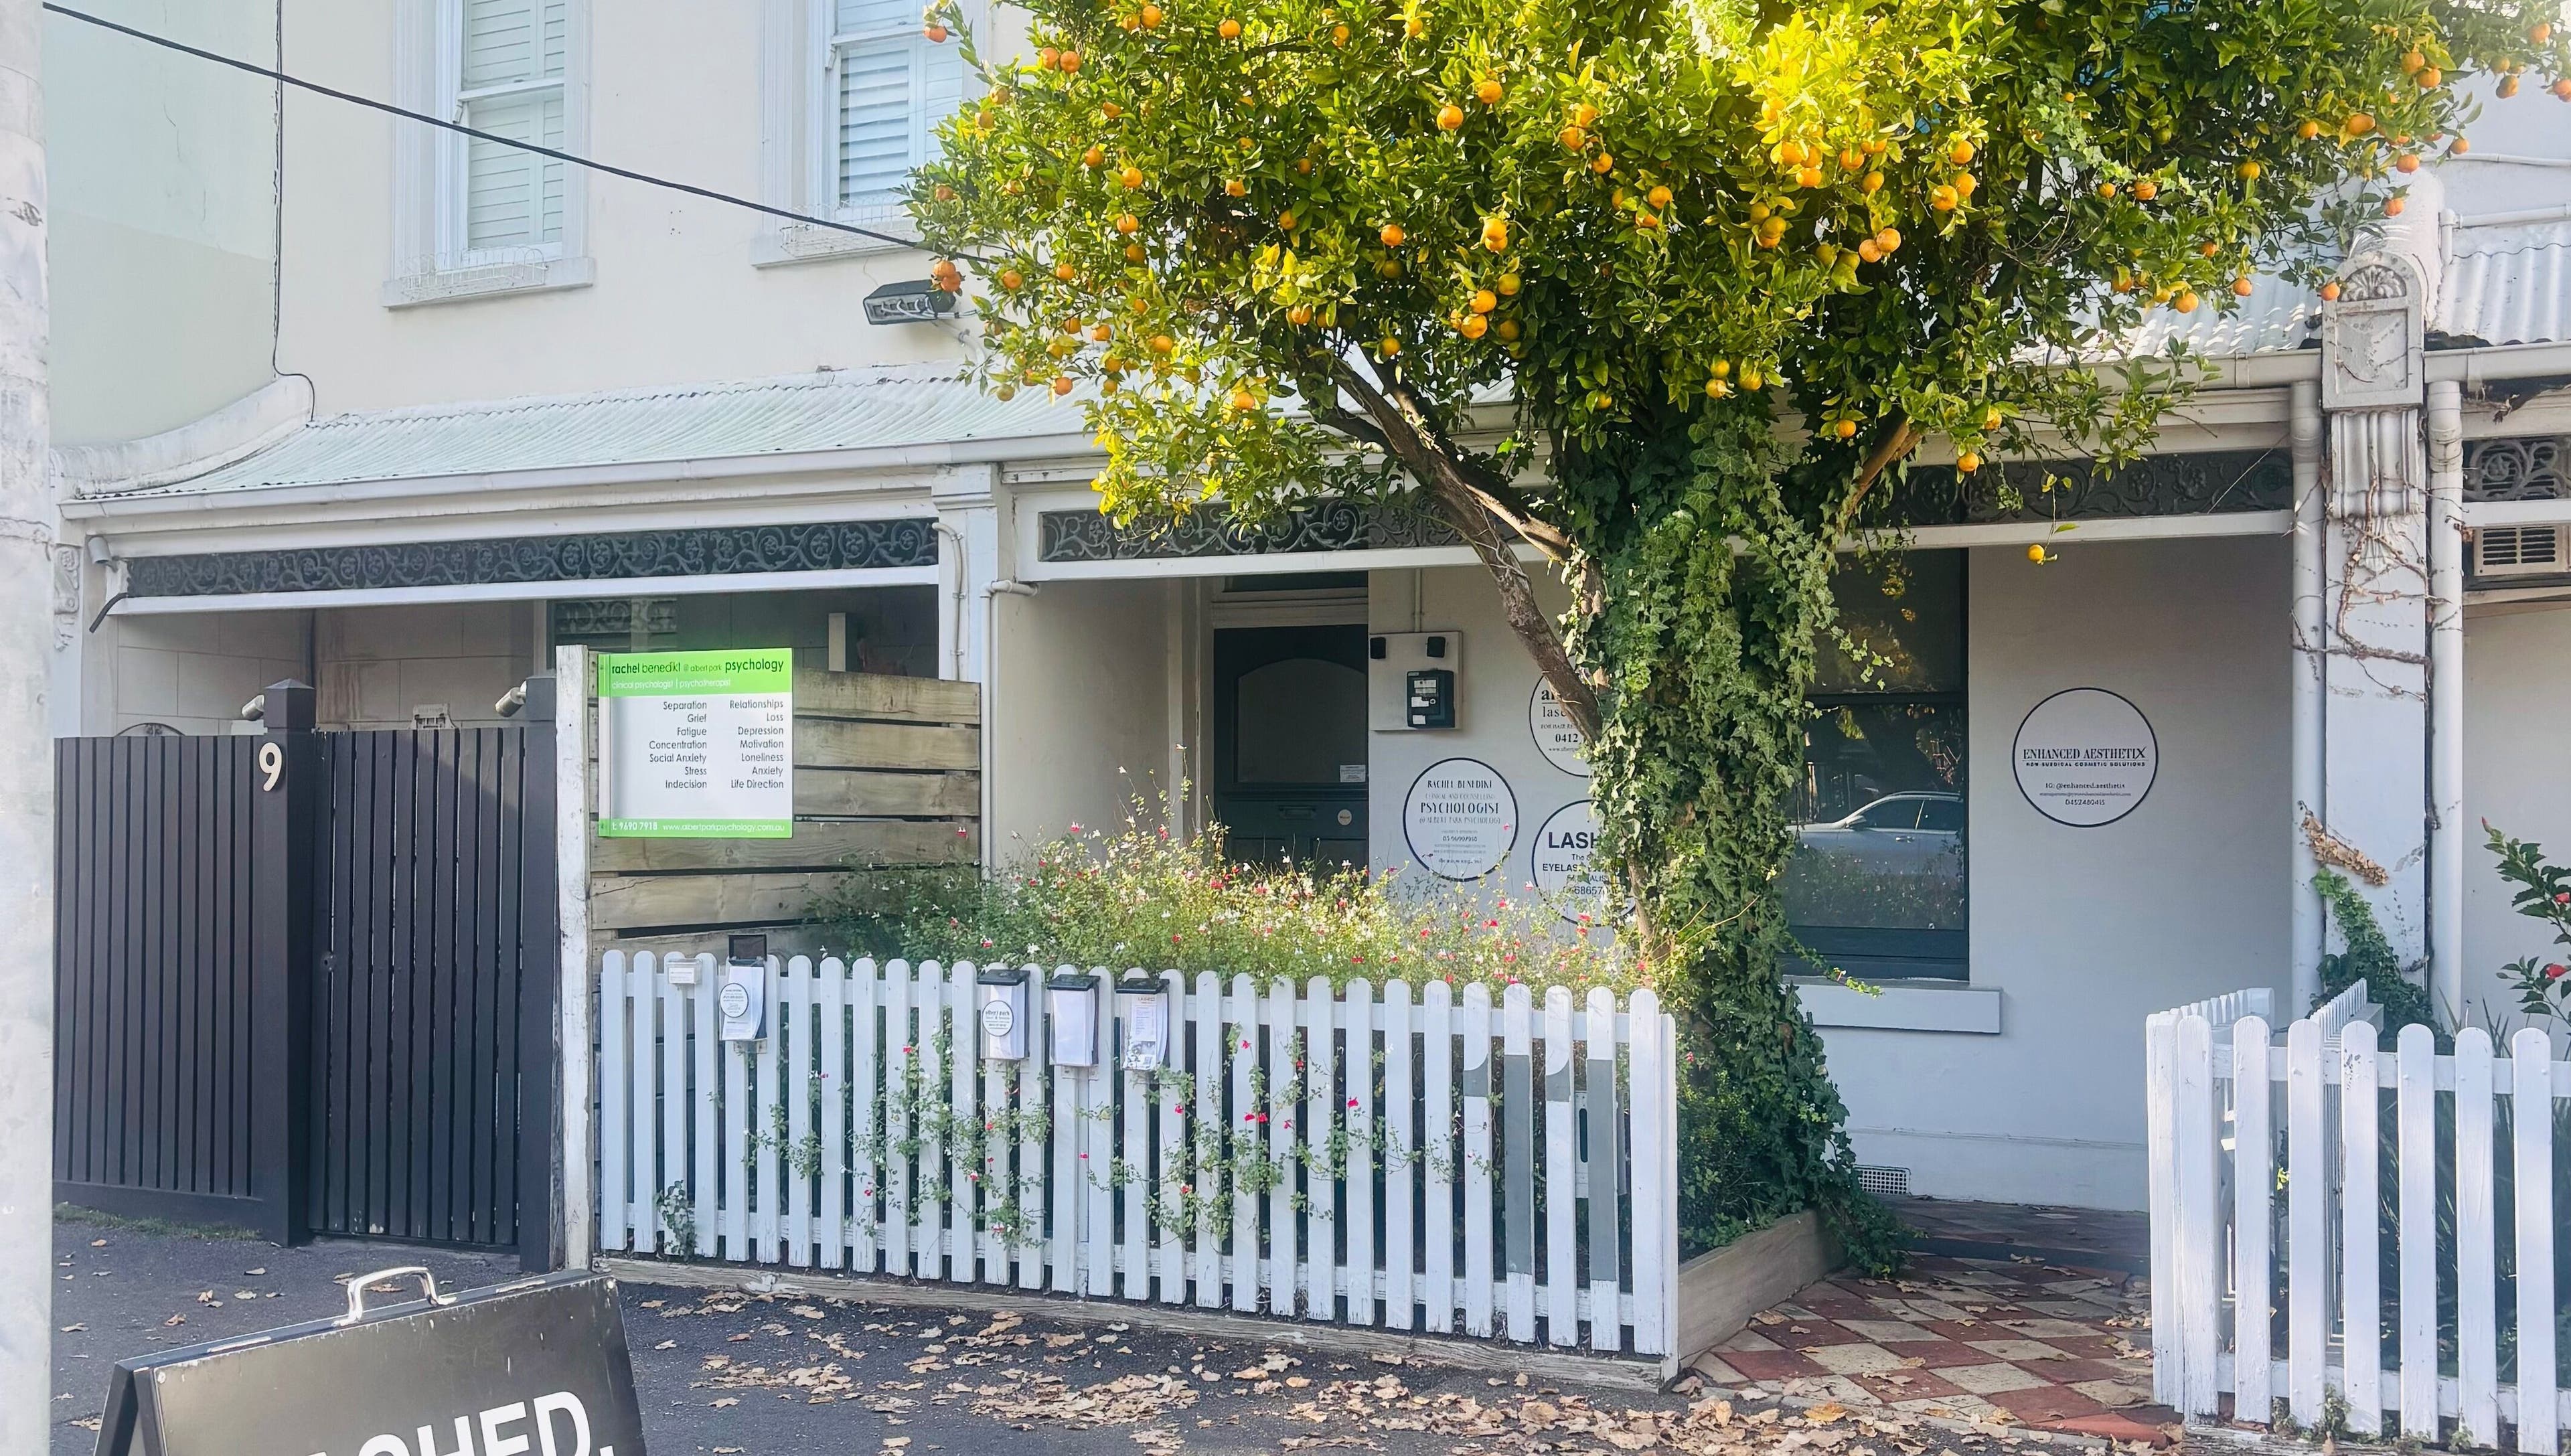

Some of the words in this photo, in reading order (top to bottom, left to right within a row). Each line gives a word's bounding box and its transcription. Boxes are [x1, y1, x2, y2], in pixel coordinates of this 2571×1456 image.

[612, 663, 640, 674] rachel
[725, 659, 784, 673] psychology
[612, 680, 634, 689] clinical
[635, 679, 674, 691] psychologist
[680, 677, 731, 690] psychotherapist
[663, 702, 708, 711] Separation
[730, 700, 783, 710] Relationships
[687, 714, 707, 723] Grief
[767, 713, 784, 722] Loss
[677, 727, 707, 738] Fatigue
[738, 726, 784, 737] Depression
[1555, 733, 1578, 742] 0412
[649, 740, 707, 750] Concentration
[740, 739, 784, 749] Motivation
[741, 752, 784, 762] Loneliness
[2023, 748, 2080, 760] ENHANCED
[2084, 746, 2147, 760] AESTHETIX
[649, 754, 674, 763] Social
[676, 754, 707, 764] Anxiety
[258, 742, 283, 792] 9
[685, 766, 707, 776] Stress
[752, 766, 783, 777] Anxiety
[666, 779, 707, 789] Indecision
[730, 779, 745, 789] Life
[747, 779, 784, 789] Direction
[1427, 780, 1453, 789] RACHEL
[1420, 802, 1499, 814] PSYCHOLOGIST
[619, 821, 638, 831] 9690
[639, 821, 658, 831] 7918
[1543, 863, 1578, 872] EYELAS
